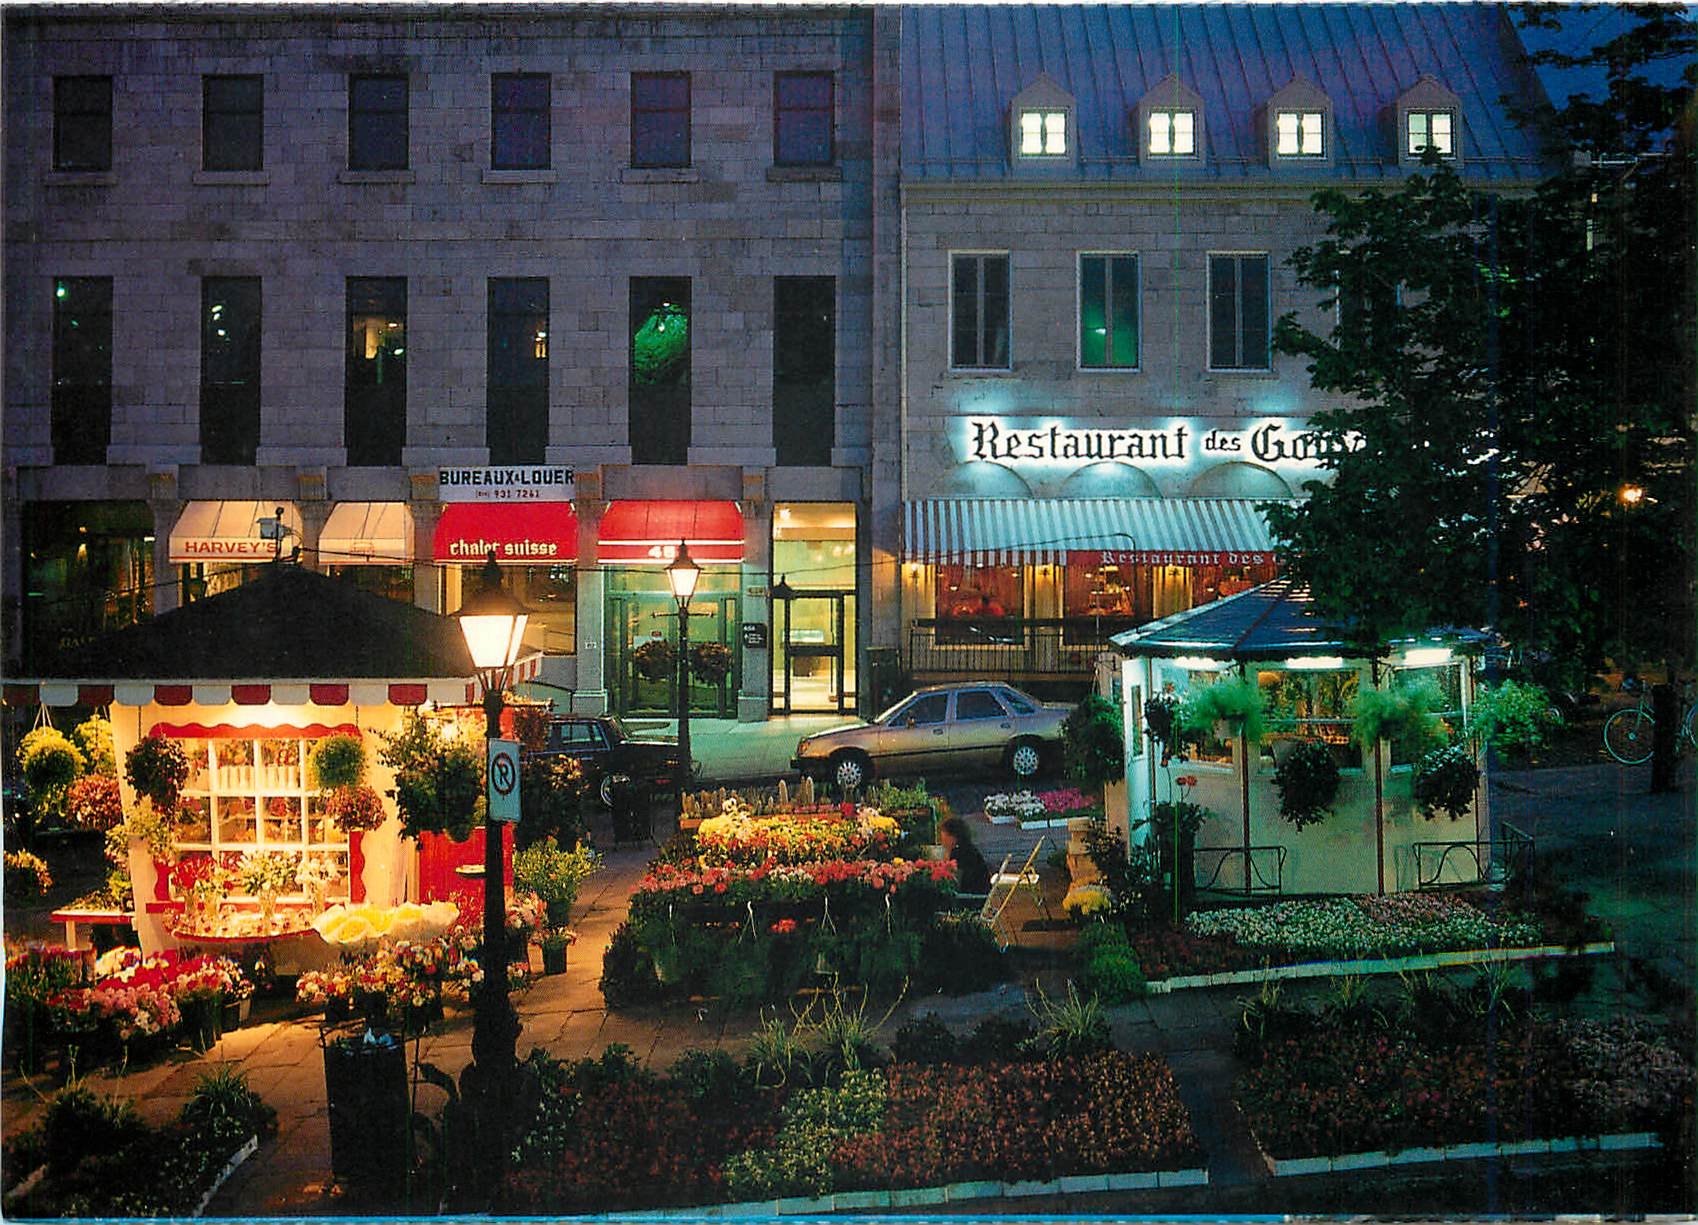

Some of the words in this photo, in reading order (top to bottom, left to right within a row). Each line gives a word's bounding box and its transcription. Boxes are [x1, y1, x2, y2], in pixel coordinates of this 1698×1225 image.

[971, 420, 1189, 460] Restaurant
[1205, 427, 1241, 452] des
[439, 470, 514, 485] BUREAUX
[521, 469, 575, 485] LOUER
[184, 541, 278, 554] HARVEY'S
[449, 539, 501, 555] chalet
[504, 538, 558, 556] suisse
[1101, 551, 1221, 565] Restaurant
[1229, 553, 1265, 565] des
